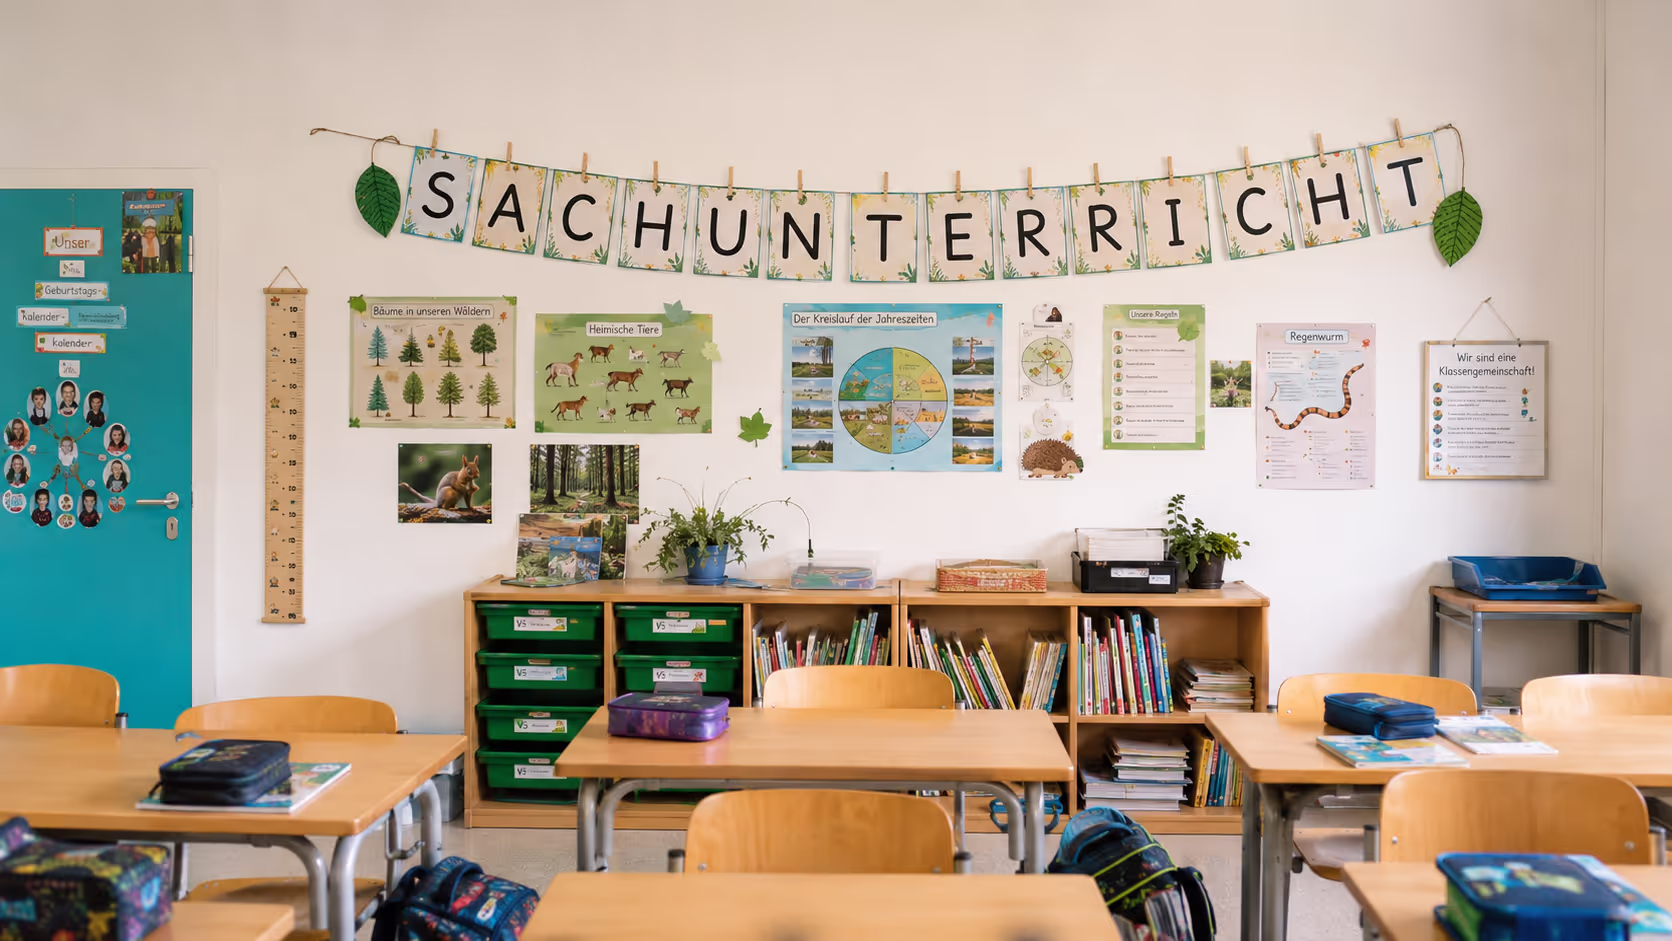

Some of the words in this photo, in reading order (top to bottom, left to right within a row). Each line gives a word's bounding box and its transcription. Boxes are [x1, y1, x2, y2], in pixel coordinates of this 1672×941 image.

[421, 156, 1424, 262] SACHUNTERRICHT
[54, 233, 91, 249] Unser
[44, 284, 103, 297] Geburtstags-
[373, 306, 404, 317] Bäume
[405, 306, 414, 317] in
[416, 308, 451, 317] unseren
[453, 306, 491, 317] Wäldern
[793, 314, 811, 324] Der
[813, 313, 855, 324] Kreislauf
[857, 313, 873, 324] der
[875, 313, 935, 324] Jahreszeiten
[588, 324, 635, 335] Heimische
[637, 324, 660, 335] Tiere
[1290, 331, 1344, 343] Regenwurm
[1456, 352, 1474, 362] Wir
[1476, 352, 1495, 362] sind
[1498, 353, 1517, 362] eine
[1439, 365, 1536, 378] Klassengemeinschaft!
